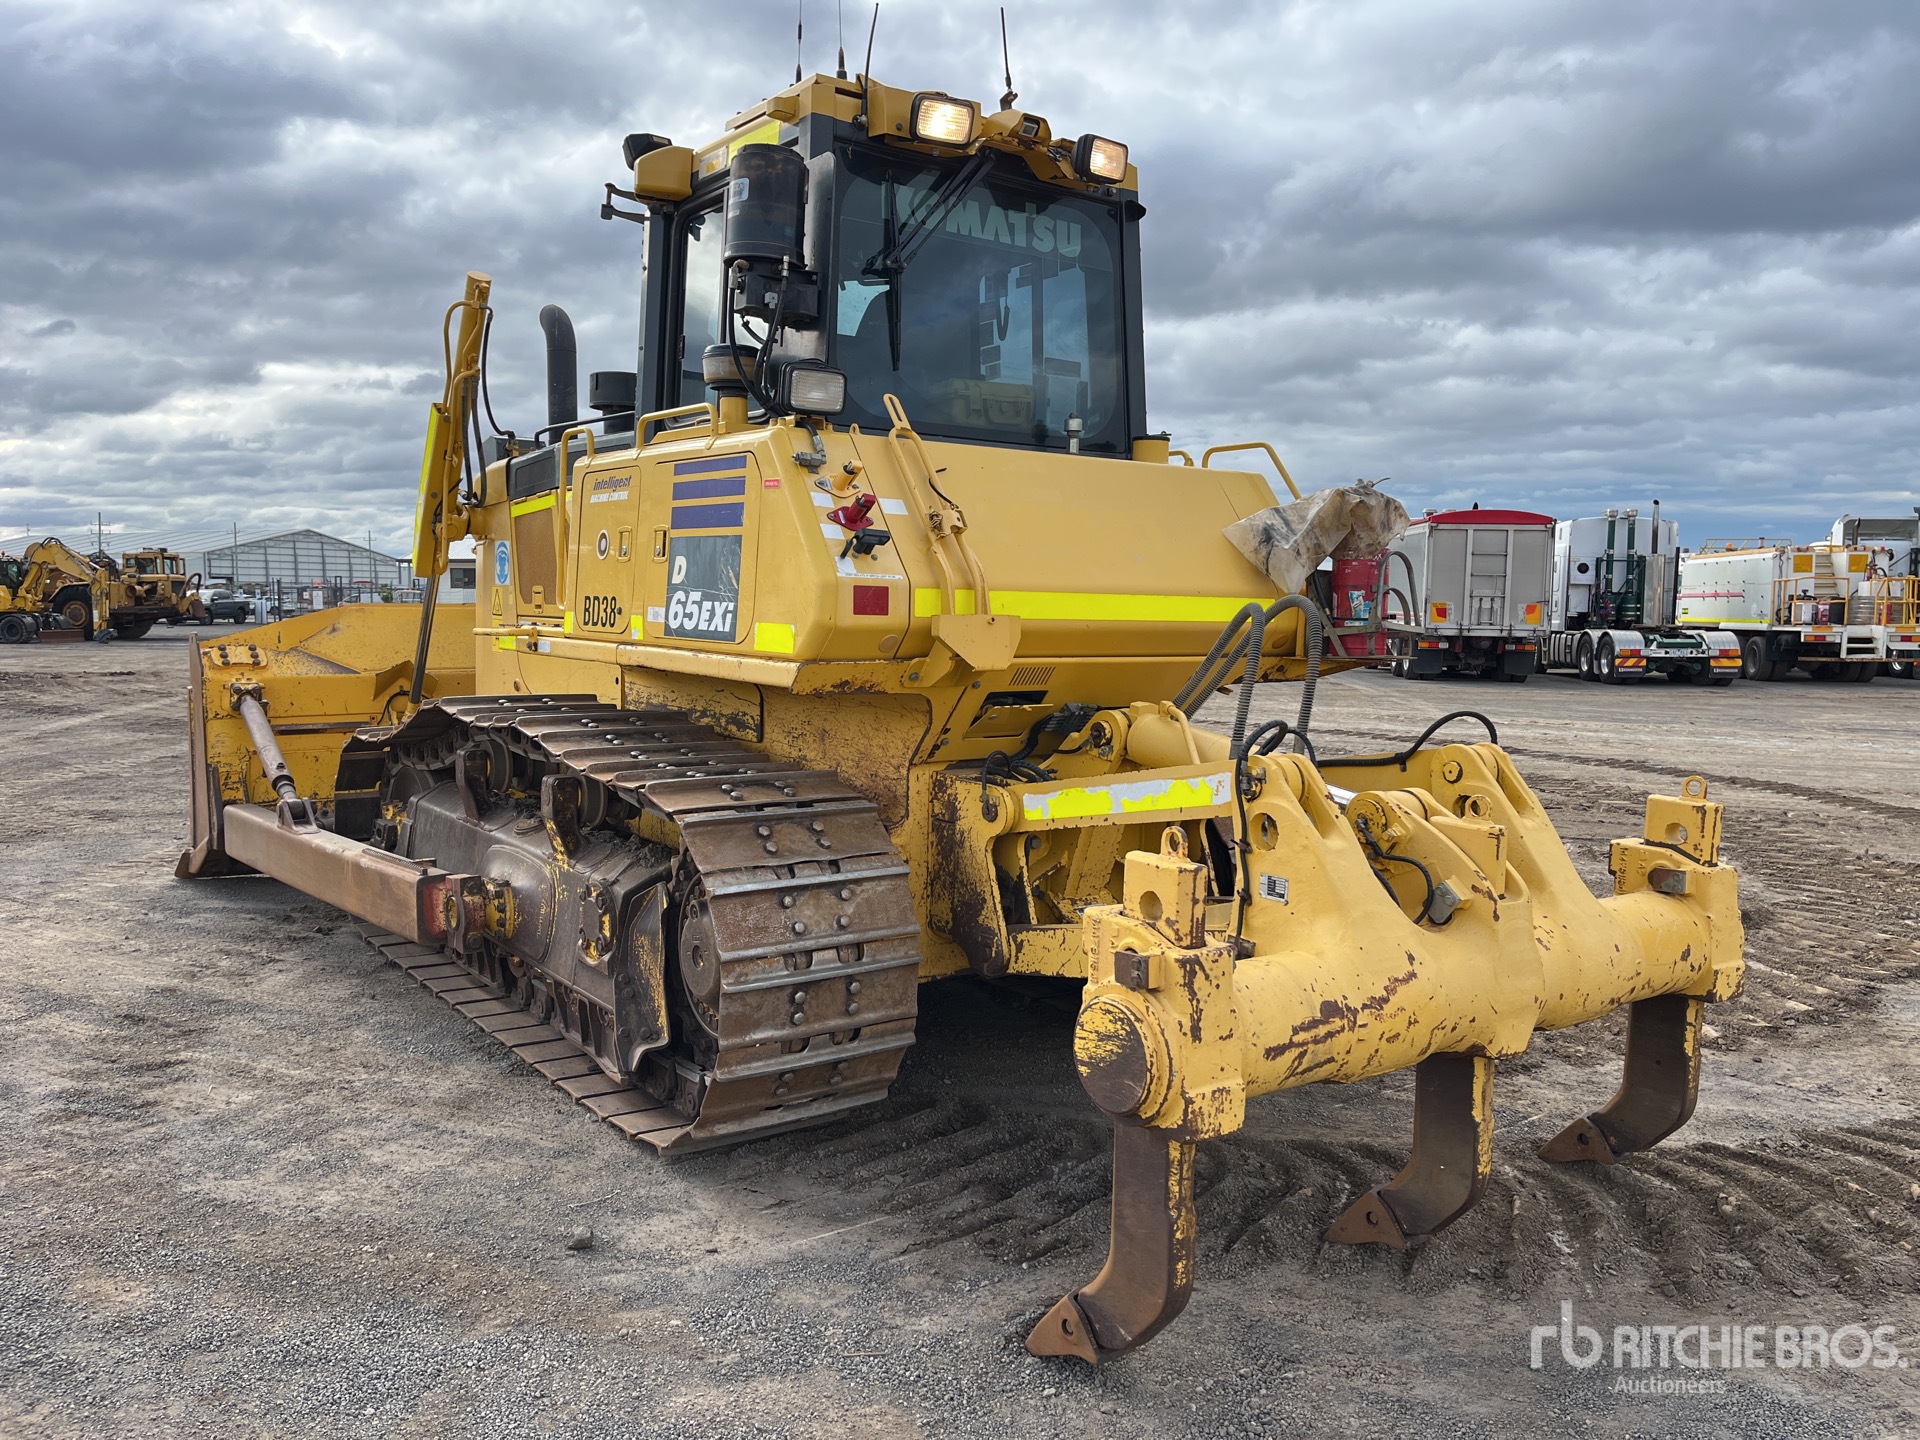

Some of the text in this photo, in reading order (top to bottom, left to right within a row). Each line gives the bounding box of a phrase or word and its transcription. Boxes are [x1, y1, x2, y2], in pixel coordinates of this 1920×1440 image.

[881, 181, 1082, 258] KOMATSU
[593, 475, 632, 492] intelligent
[671, 555, 687, 584] D
[583, 595, 617, 628] BD38
[668, 590, 735, 632] 65EXi
